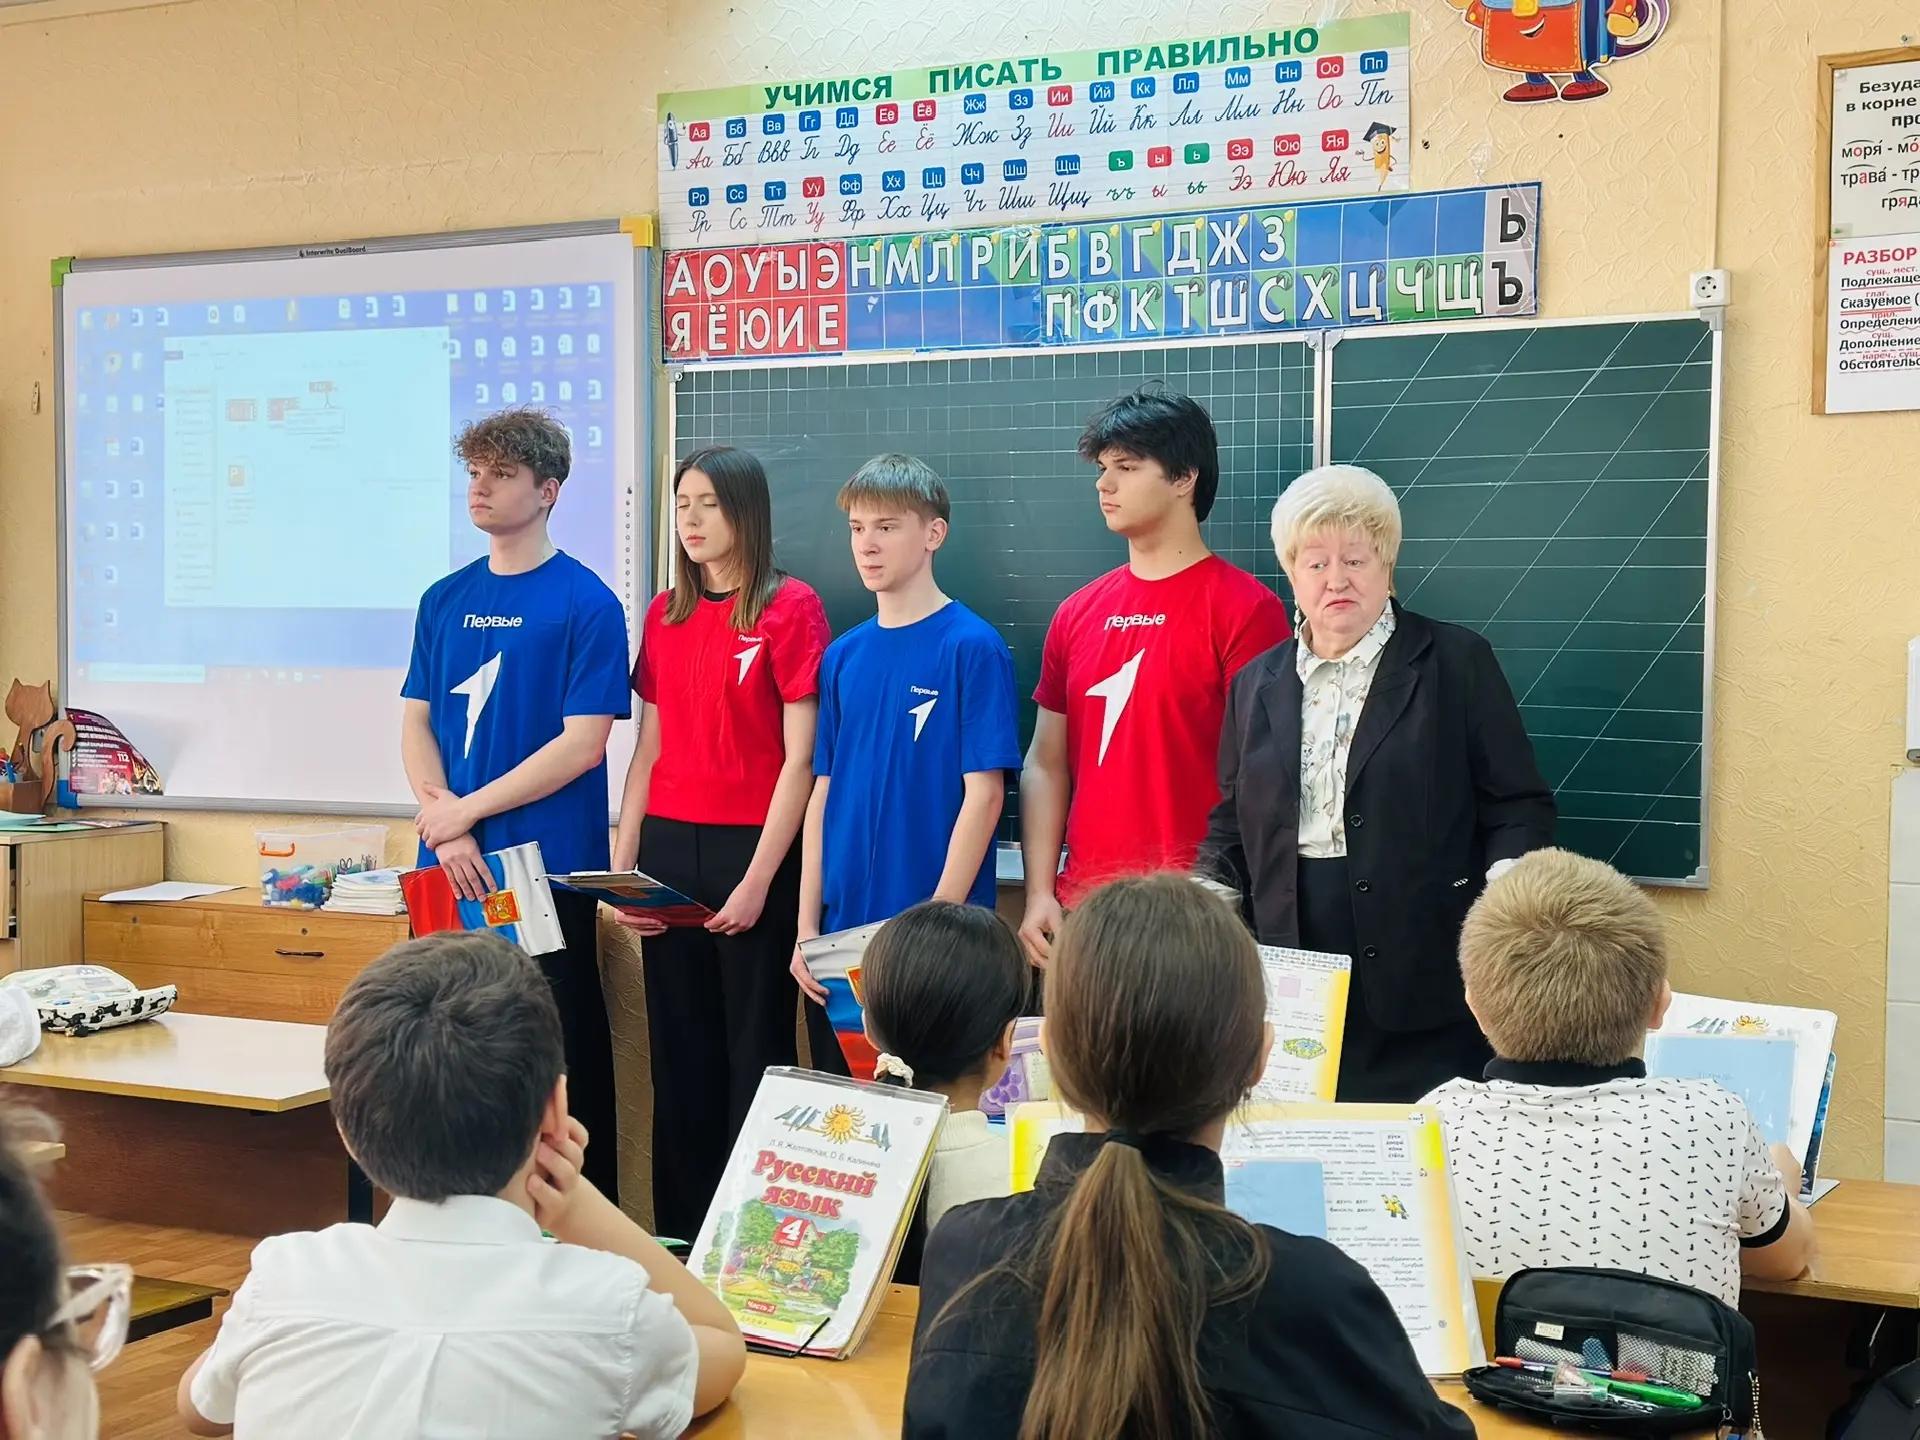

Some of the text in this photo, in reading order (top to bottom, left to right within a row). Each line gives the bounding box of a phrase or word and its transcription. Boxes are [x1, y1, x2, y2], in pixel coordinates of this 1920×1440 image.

[764, 27, 1319, 109] УЧИМСЯ ПИСАТЬ ПРАВИЛЬНО
[691, 57, 1384, 139] Аа Бб Вв Гг Дд Ее Ёё Жж Зз Ии Йй Кк Лл Мм Нн Оо Пп
[1846, 96, 1917, 112] в корне
[691, 134, 1345, 205] Рр Сс Тт Уу Фф Хх Цц Чч Шш Щщ ъ ы ь Ээ Юю Яя
[1844, 247, 1917, 265] РАЗБОР
[1841, 295, 1911, 310] Сказуемое
[463, 614, 523, 631] Первые
[1104, 613, 1166, 632] Первые
[738, 634, 762, 643] Первые
[910, 685, 939, 696] Первые
[117, 753, 130, 762] 112
[752, 1150, 878, 1198] Русский
[760, 1185, 844, 1219] язык
[781, 1219, 803, 1241] 4
